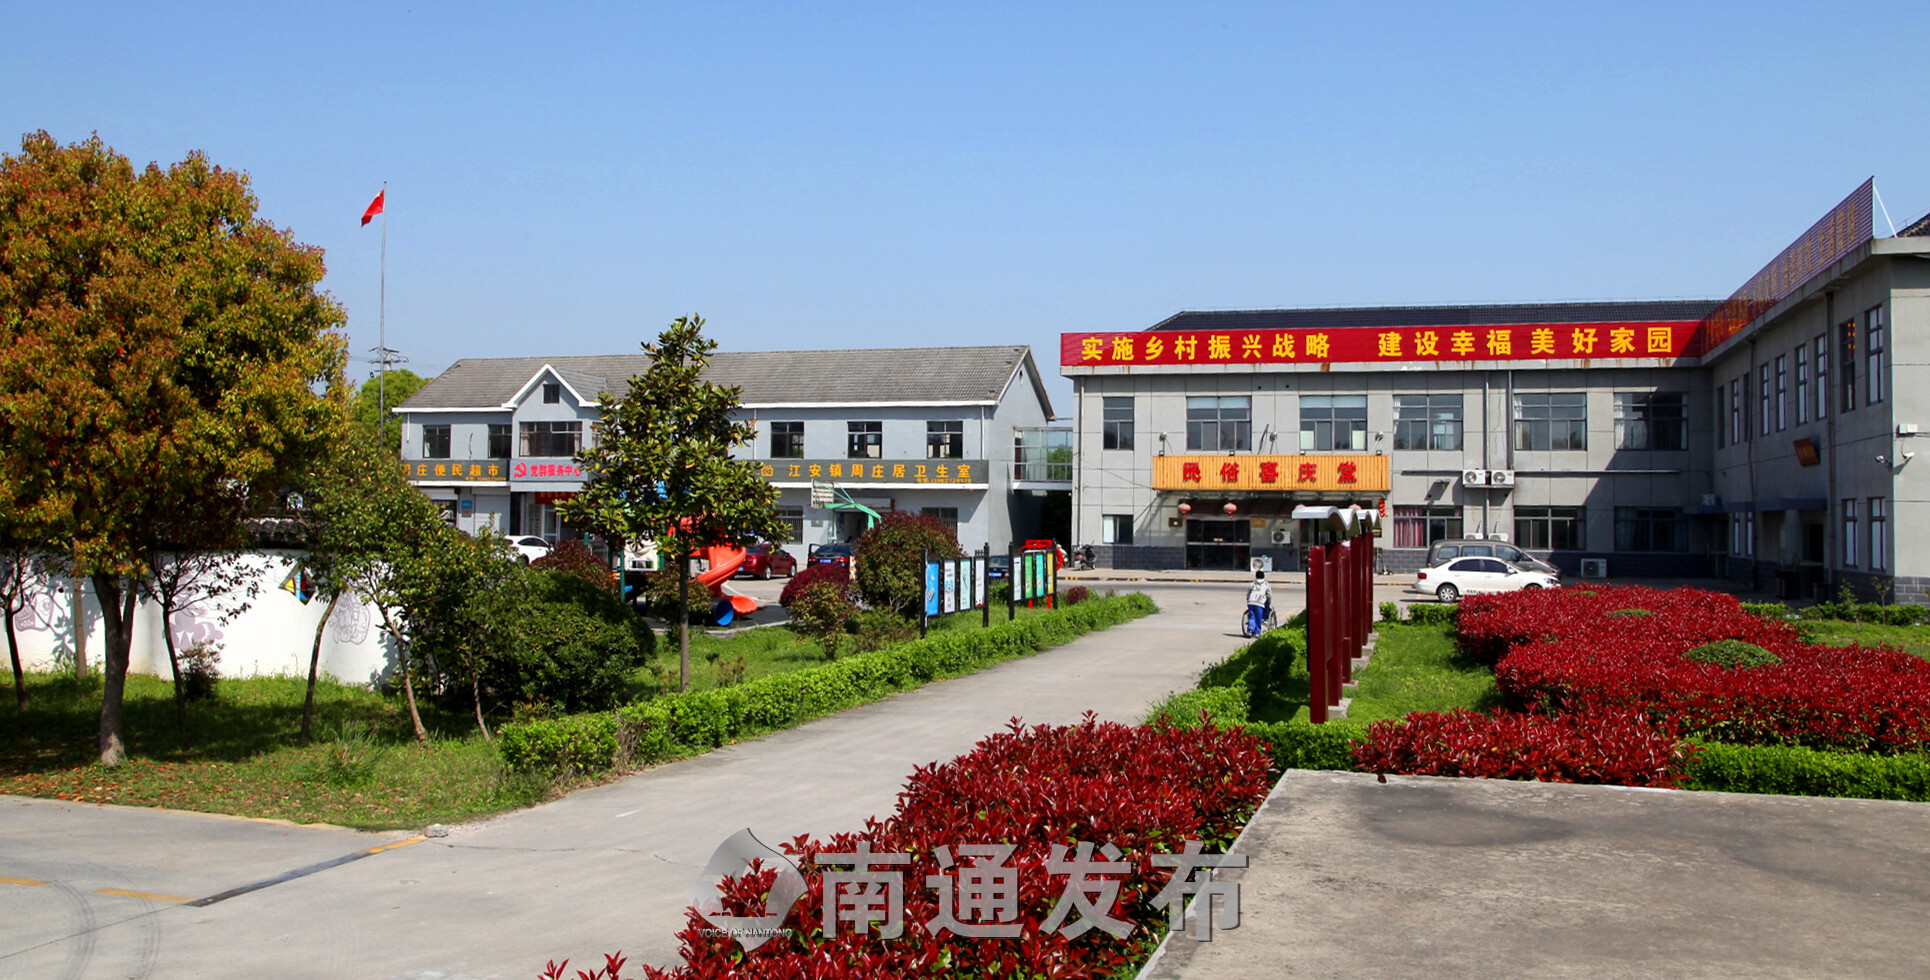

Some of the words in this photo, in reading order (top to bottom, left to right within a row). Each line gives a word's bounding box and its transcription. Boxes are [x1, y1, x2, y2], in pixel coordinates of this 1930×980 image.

[1082, 333, 1330, 361] 实施乡村振兴战略
[1378, 327, 1672, 357] 建设幸福美好家园
[530, 464, 583, 477] 党群服务中心
[789, 464, 972, 478] 江安镇周庄居卫生室
[1182, 461, 1358, 483] 民俗喜庆堂
